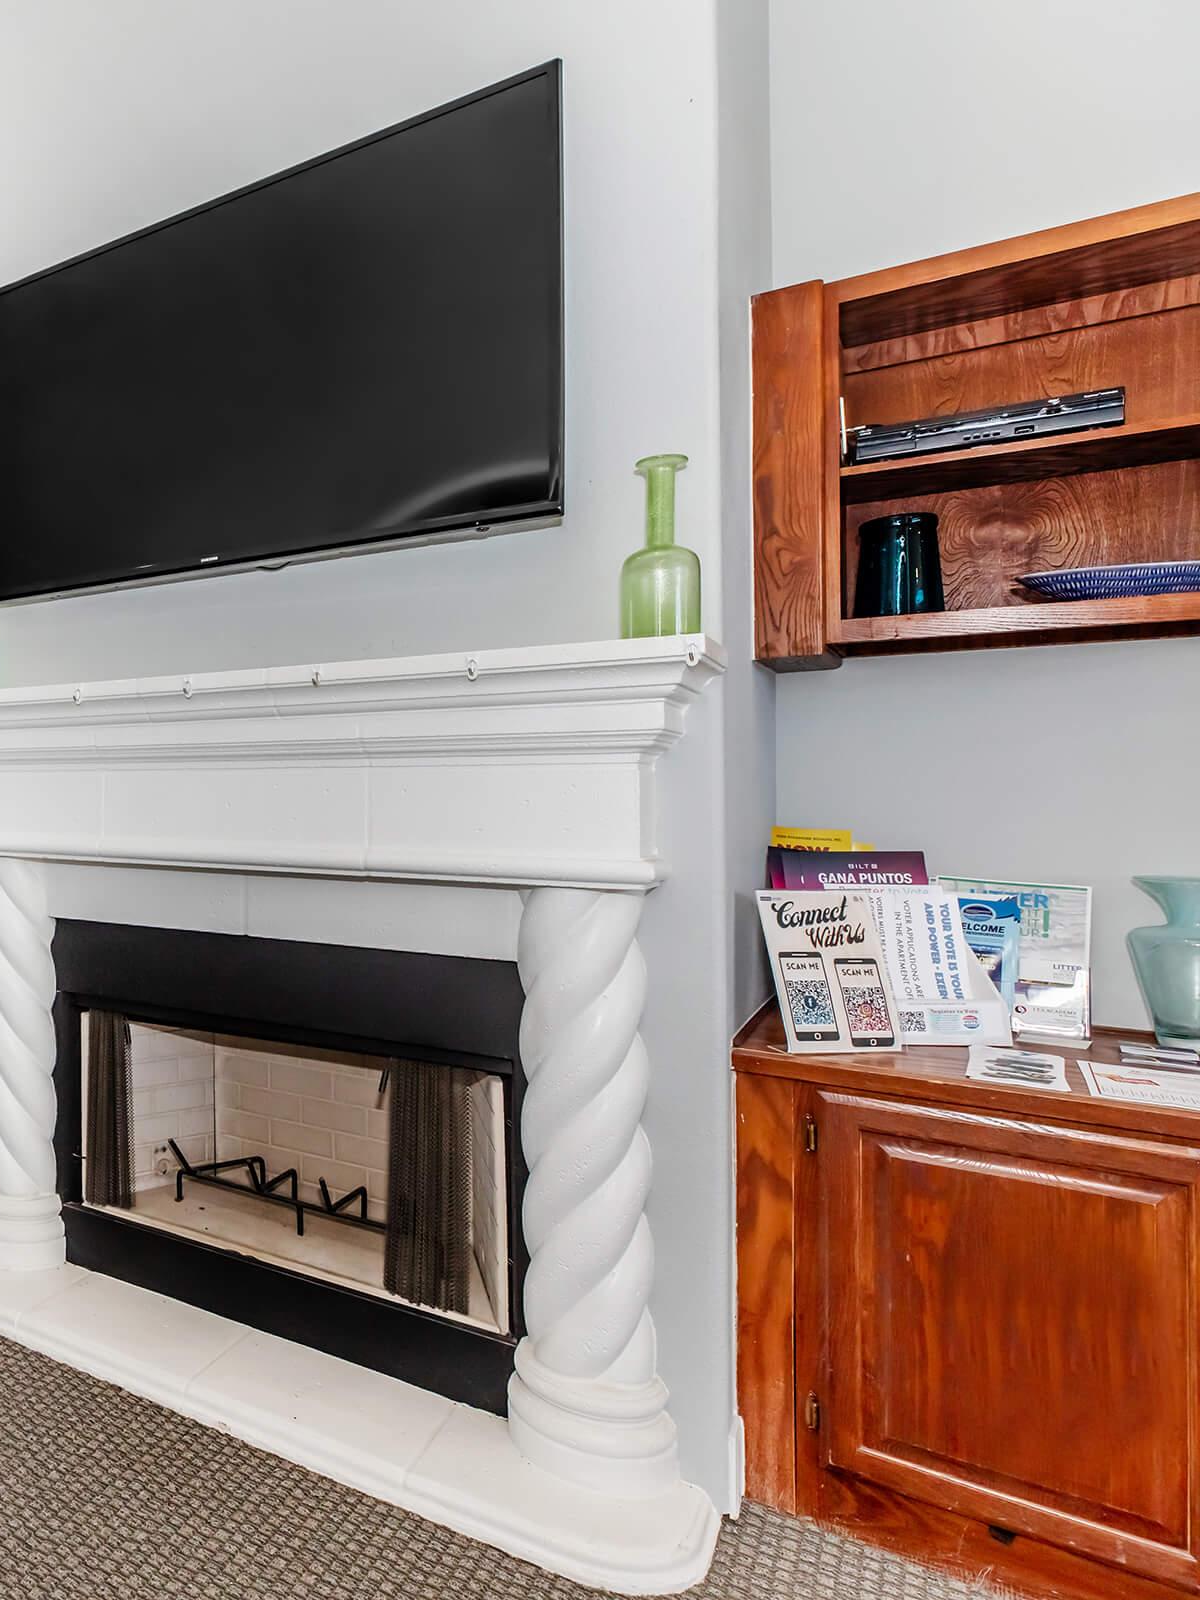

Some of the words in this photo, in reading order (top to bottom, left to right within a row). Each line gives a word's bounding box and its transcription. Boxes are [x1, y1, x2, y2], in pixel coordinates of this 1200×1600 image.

[818, 872, 857, 884] GANA
[859, 872, 913, 885] PUNTOS
[771, 895, 848, 929] Connect
[895, 911, 902, 920] IN
[903, 899, 913, 924] VOTER
[923, 902, 935, 925] AND
[938, 903, 952, 931] YOUR
[805, 924, 843, 949] With
[843, 922, 865, 945] Us
[961, 922, 1006, 934] ELCOME
[905, 926, 920, 982] APPLICATIONS
[927, 927, 941, 964] POWER
[943, 934, 956, 960] VOTE
[786, 962, 808, 970] SCAN
[809, 962, 820, 970] ME
[841, 968, 862, 976] SCAN
[862, 968, 875, 976] ME
[896, 937, 910, 985] APARTMENT
[948, 961, 959, 971] IS
[915, 983, 925, 998] ARE
